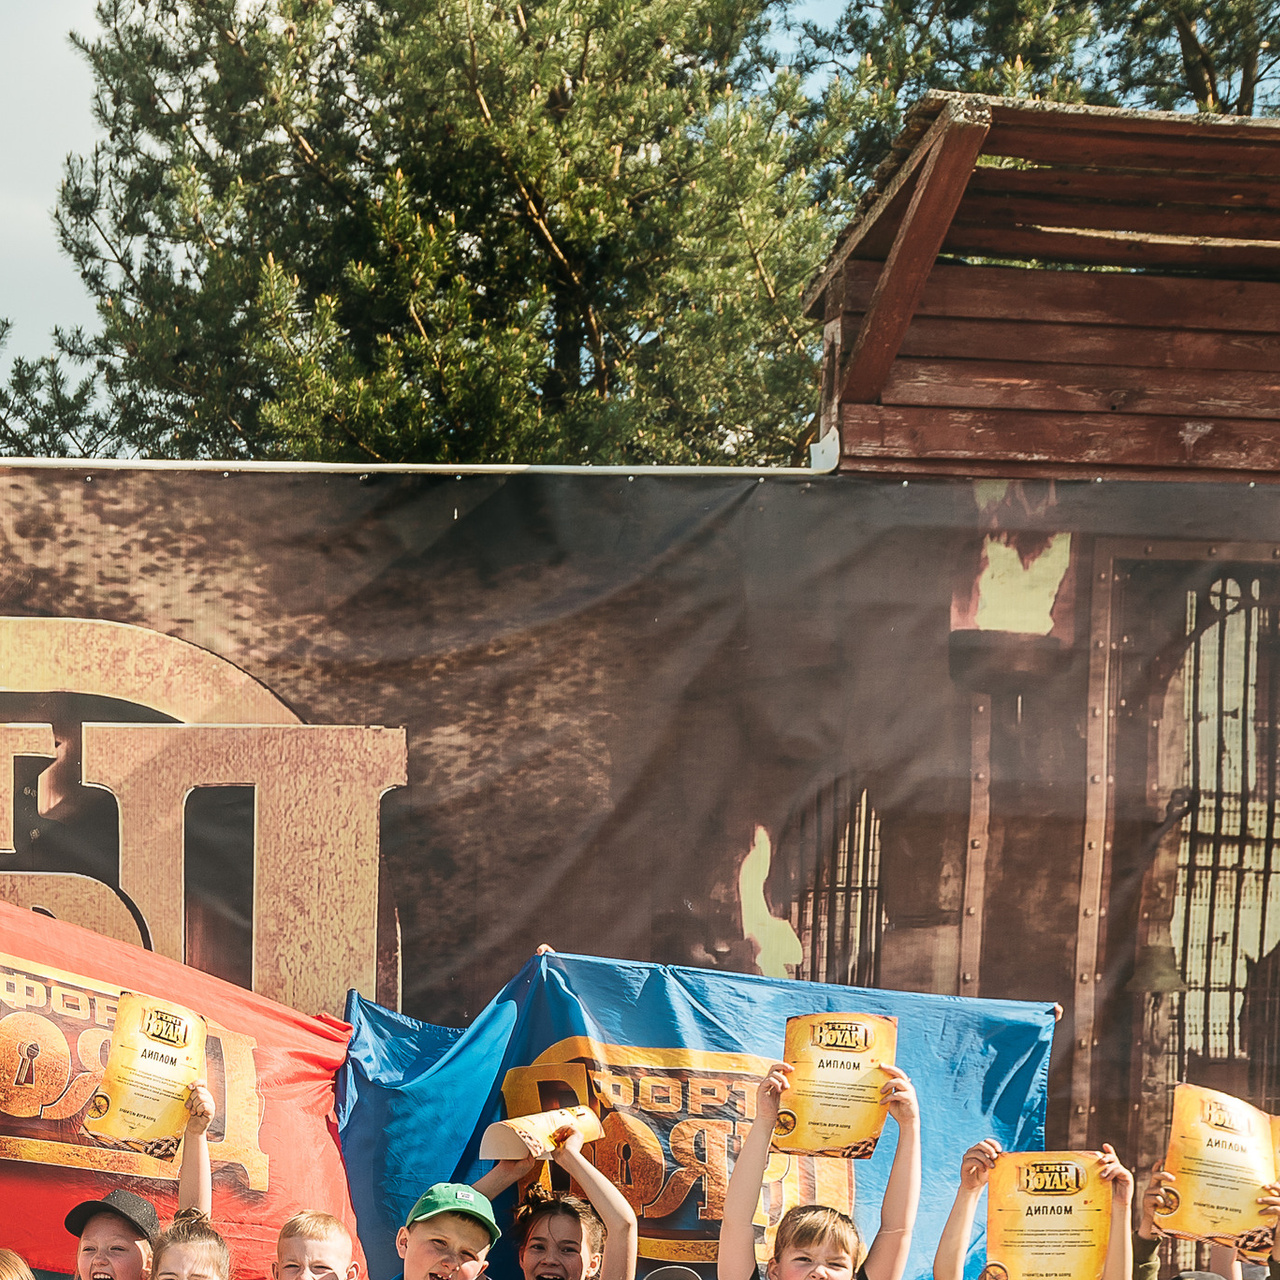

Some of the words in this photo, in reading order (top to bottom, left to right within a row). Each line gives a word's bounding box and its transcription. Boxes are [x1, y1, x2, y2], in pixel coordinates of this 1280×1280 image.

[141, 1048, 177, 1066] ДИПЛОМ
[818, 1059, 861, 1070] ДИПЛОМ
[1206, 1138, 1248, 1153] ДИПЛОМ
[1025, 1205, 1073, 1216] ДИПЛОМ
